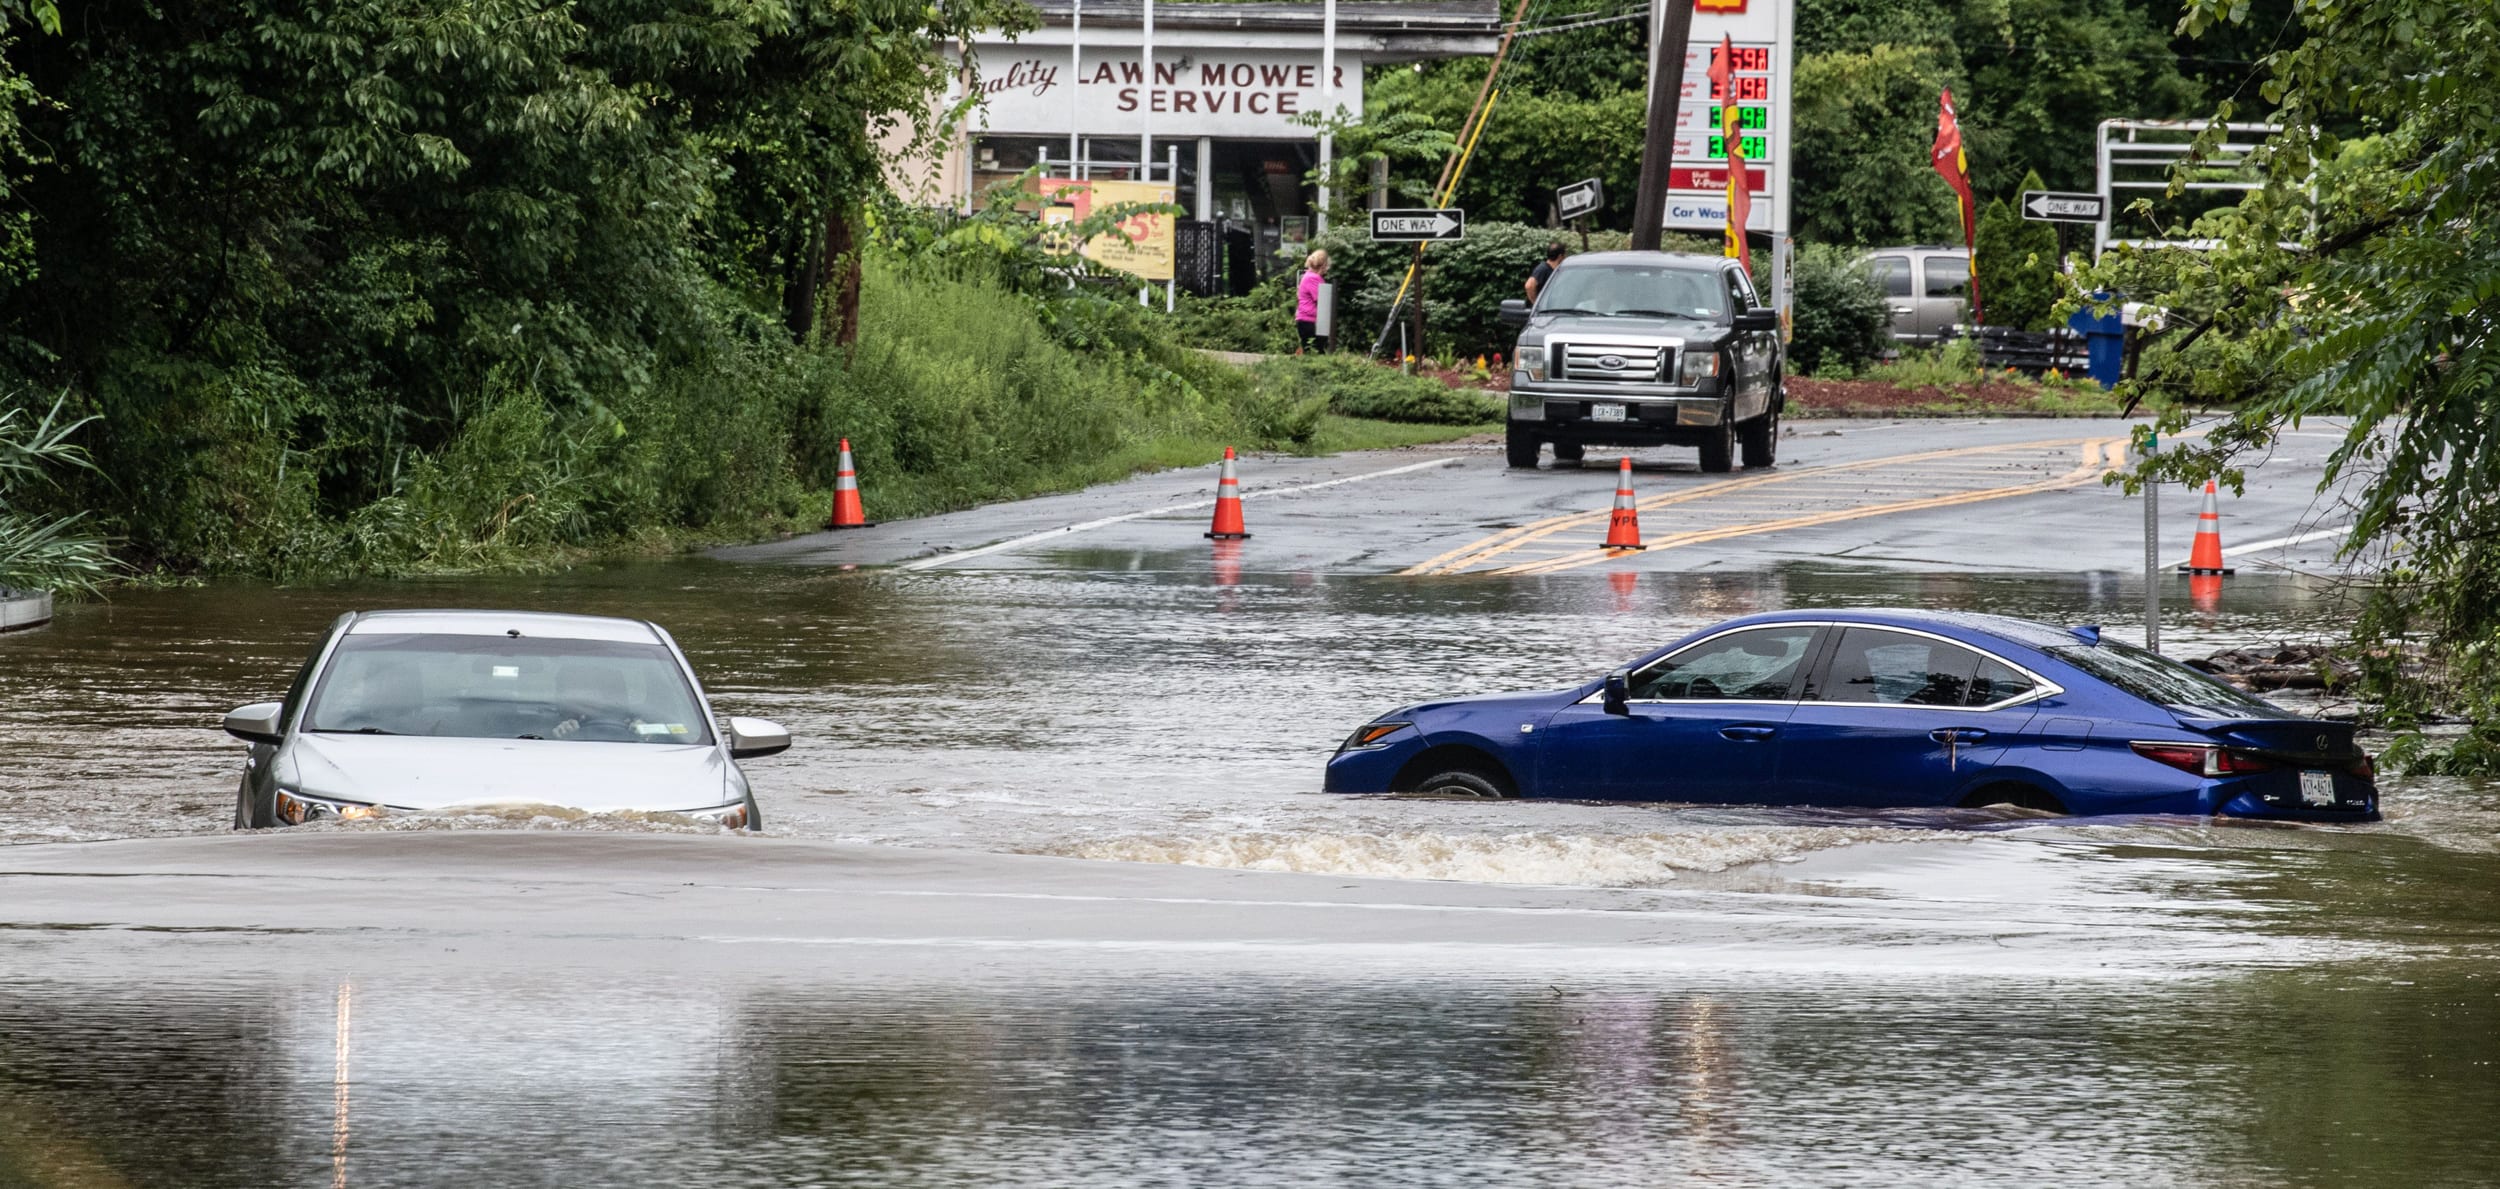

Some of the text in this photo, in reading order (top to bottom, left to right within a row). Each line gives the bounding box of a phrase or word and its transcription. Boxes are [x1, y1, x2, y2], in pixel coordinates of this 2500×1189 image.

[1078, 61, 1176, 86] LAWN
[1201, 63, 1343, 88] MOWER
[1117, 88, 1299, 114] SERVICE
[1692, 179, 1728, 189] V-Pow
[1672, 207, 1726, 219] Car Was
[2047, 202, 2096, 215] ONE WAY
[1381, 219, 1436, 232] ONE WAY
